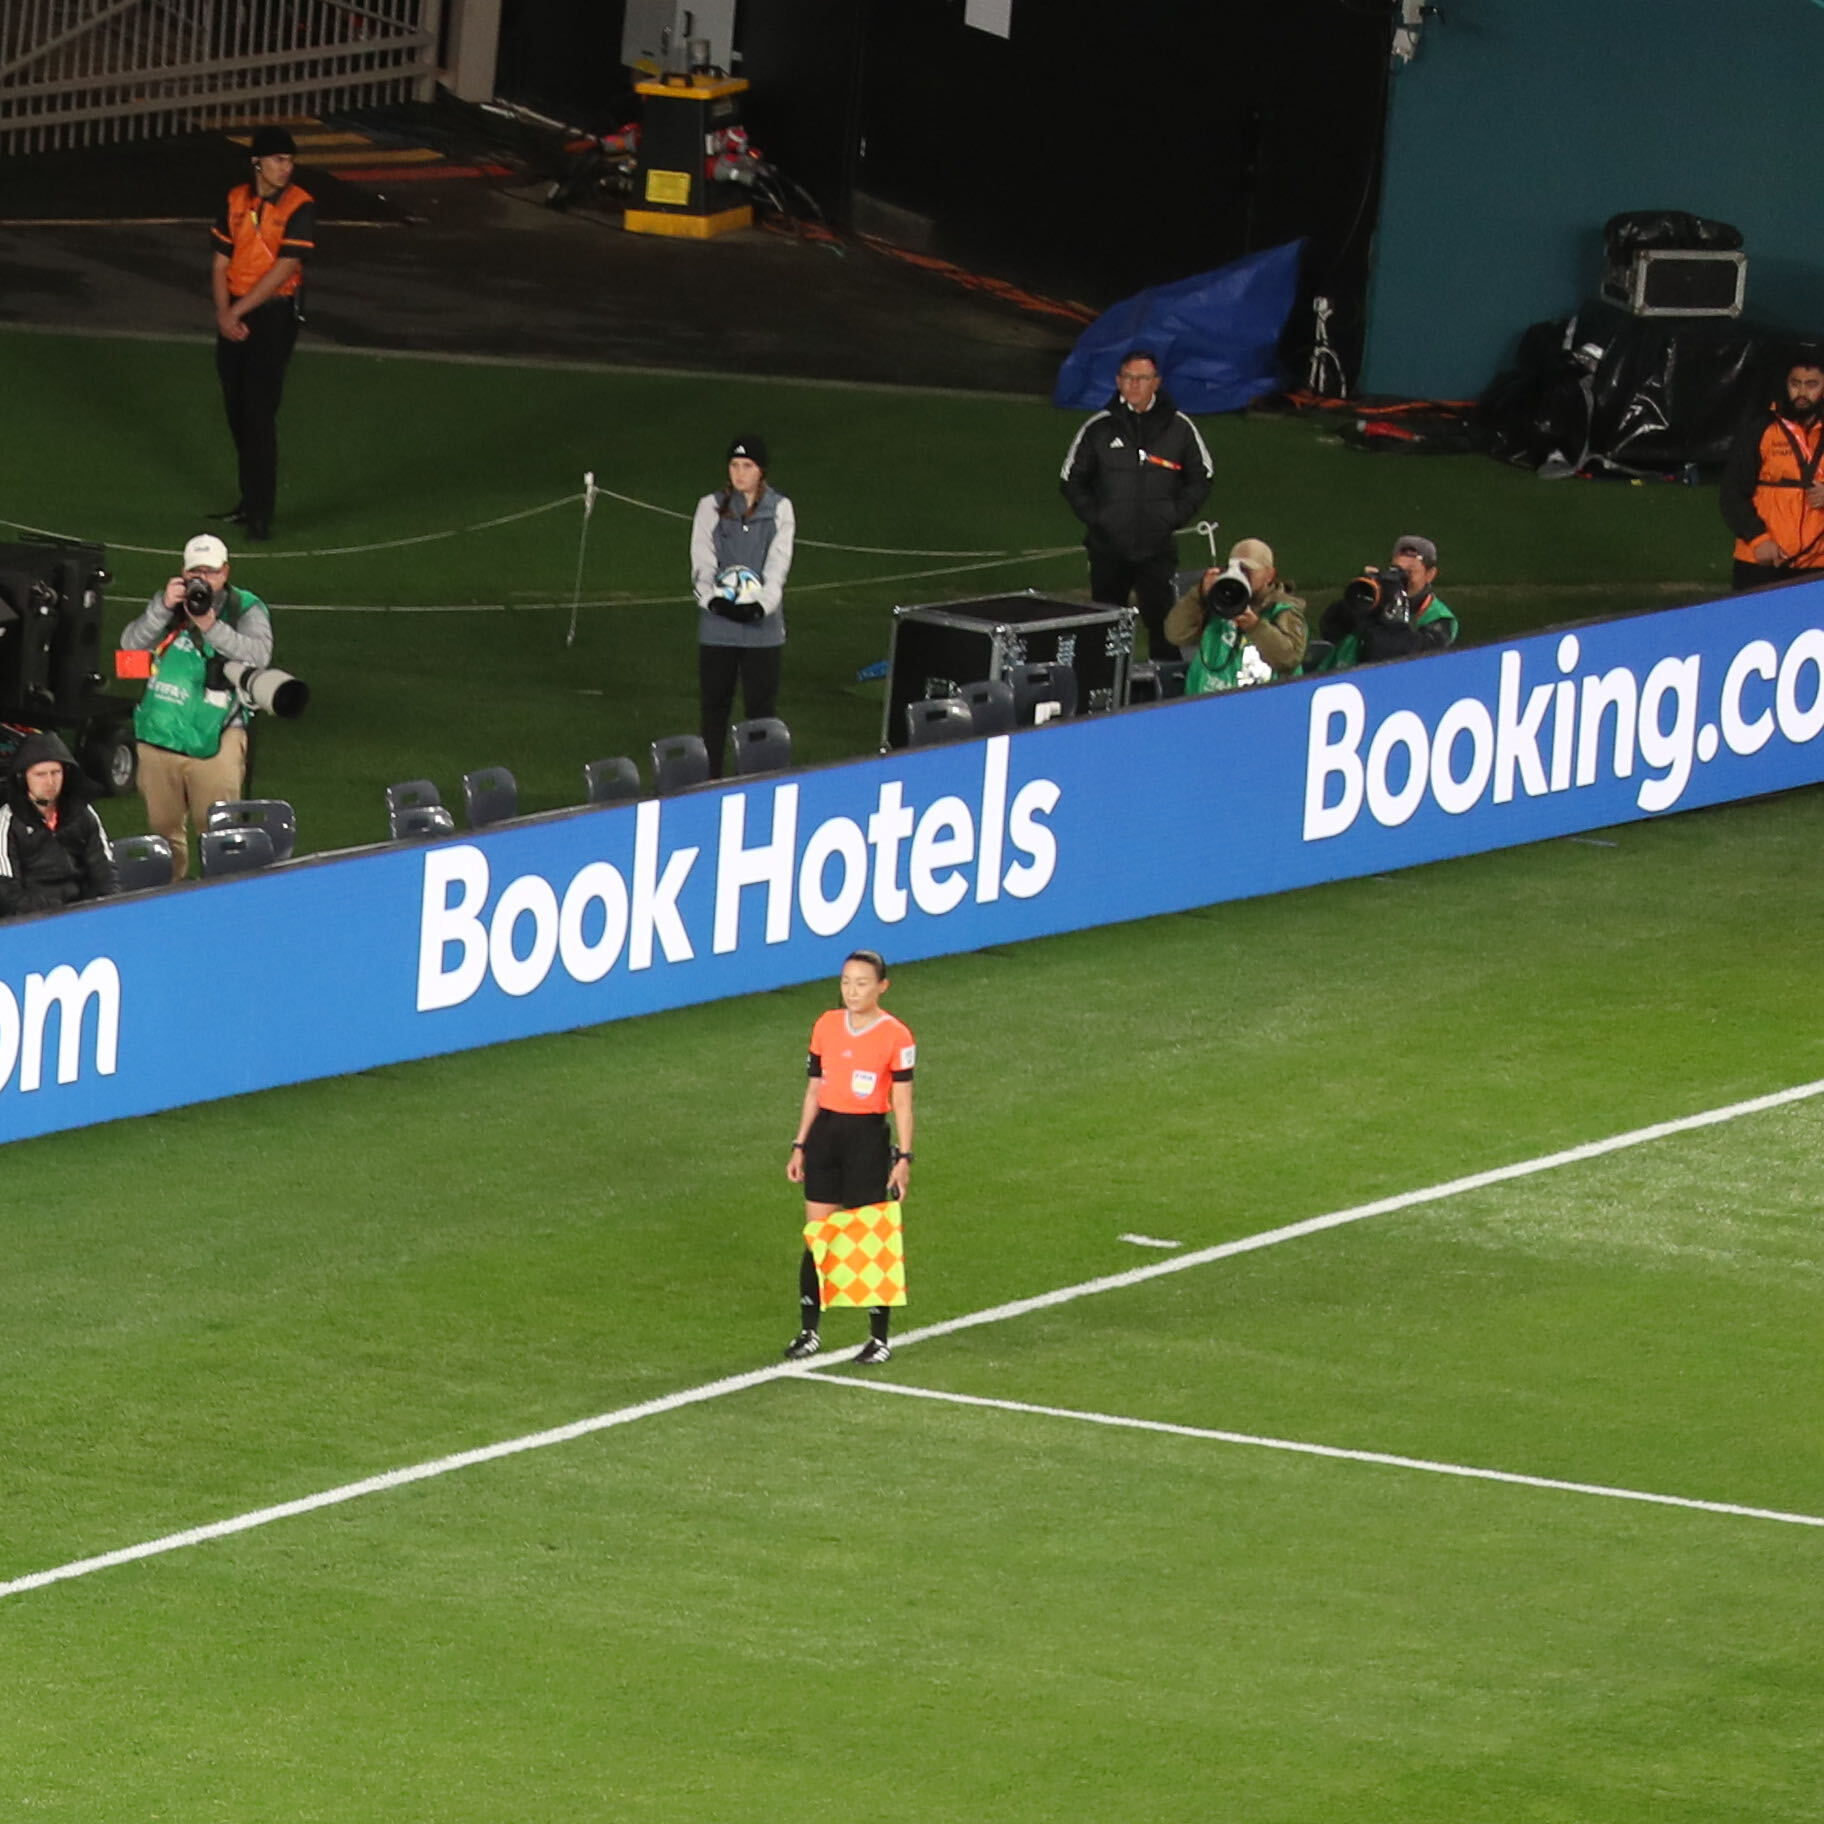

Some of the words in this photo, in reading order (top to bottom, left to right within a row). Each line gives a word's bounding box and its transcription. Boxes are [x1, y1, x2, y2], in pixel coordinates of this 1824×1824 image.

[1303, 629, 1824, 841] Booking.co
[417, 799, 699, 1011] Book
[713, 735, 1061, 954] Hotels
